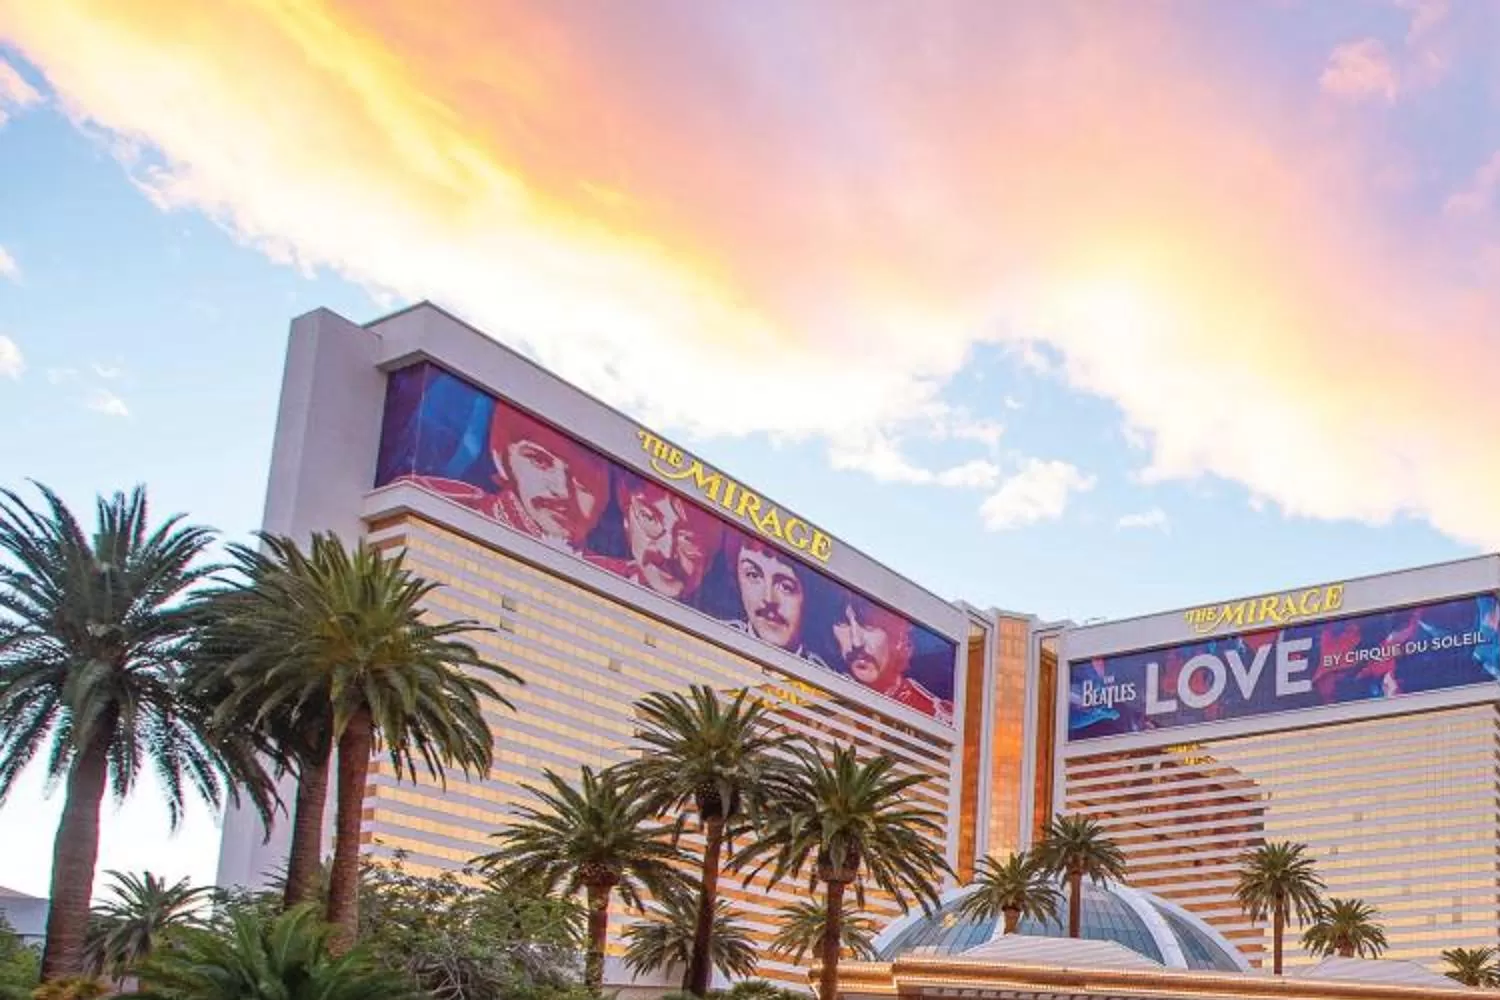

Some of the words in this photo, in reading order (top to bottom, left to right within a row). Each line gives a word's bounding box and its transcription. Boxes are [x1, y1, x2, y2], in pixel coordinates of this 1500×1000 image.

[636, 428, 685, 469] THE
[652, 459, 832, 563] MIRAGE
[1184, 607, 1218, 625] THE
[1203, 584, 1344, 633] MIRAGE
[1145, 635, 1313, 715] LOVE
[1323, 655, 1341, 667] BY
[1345, 644, 1401, 663] CIRQUE
[1405, 640, 1428, 655] DU
[1082, 680, 1137, 709] BEATLES
